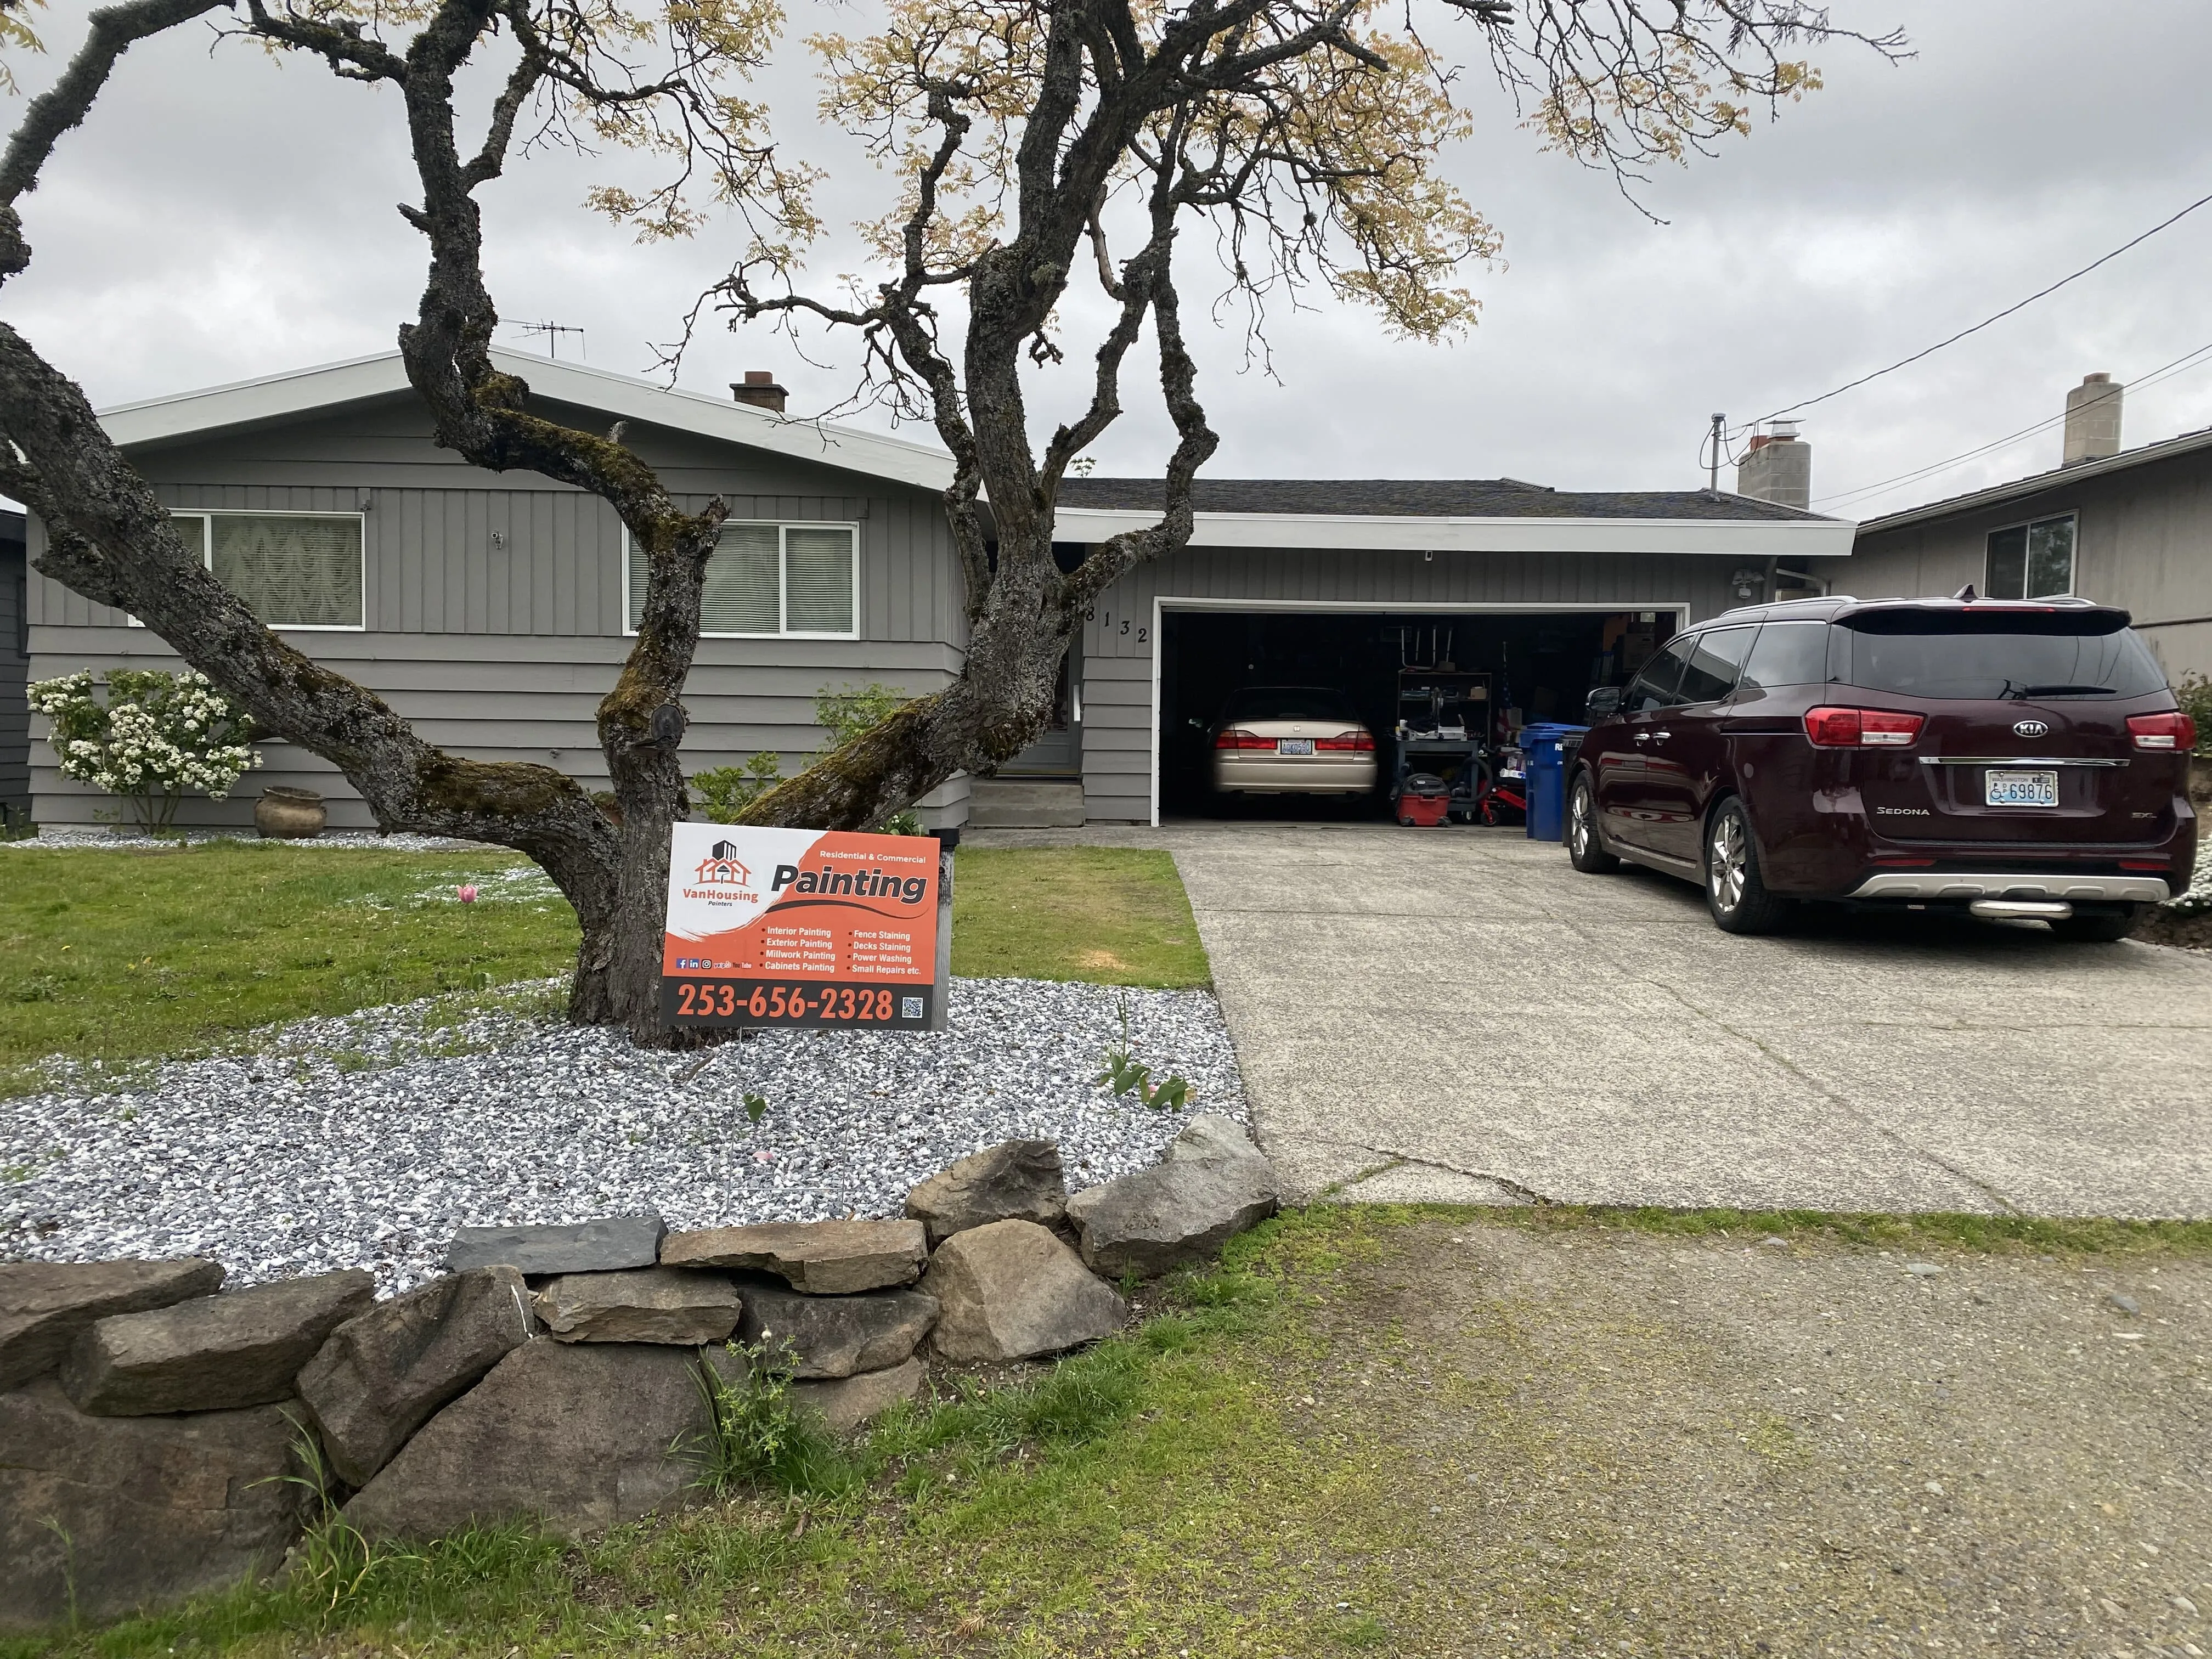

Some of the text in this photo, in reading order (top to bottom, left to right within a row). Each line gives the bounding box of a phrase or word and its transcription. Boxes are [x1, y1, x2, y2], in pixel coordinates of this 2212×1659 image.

[1086, 607, 1147, 643] 8132
[2020, 724, 2044, 734] KIA
[2010, 783, 2052, 799] 69876
[1876, 806, 1931, 816] SEDONA
[820, 850, 867, 860] Residential
[877, 854, 926, 864] Commercial
[770, 864, 928, 904] Painting
[682, 888, 759, 904] VanHousing
[768, 926, 831, 938] Interior Painting
[854, 930, 911, 942] Fence Staining
[766, 938, 832, 950] Exterior Painting
[853, 941, 911, 953] Decks Staining
[766, 950, 836, 962] Millwork Painting
[853, 953, 912, 964] Power Washing
[765, 961, 835, 973] Cabinets Painting
[852, 964, 922, 975] Small Repairs etc.
[676, 984, 894, 1021] 253-656-2328
